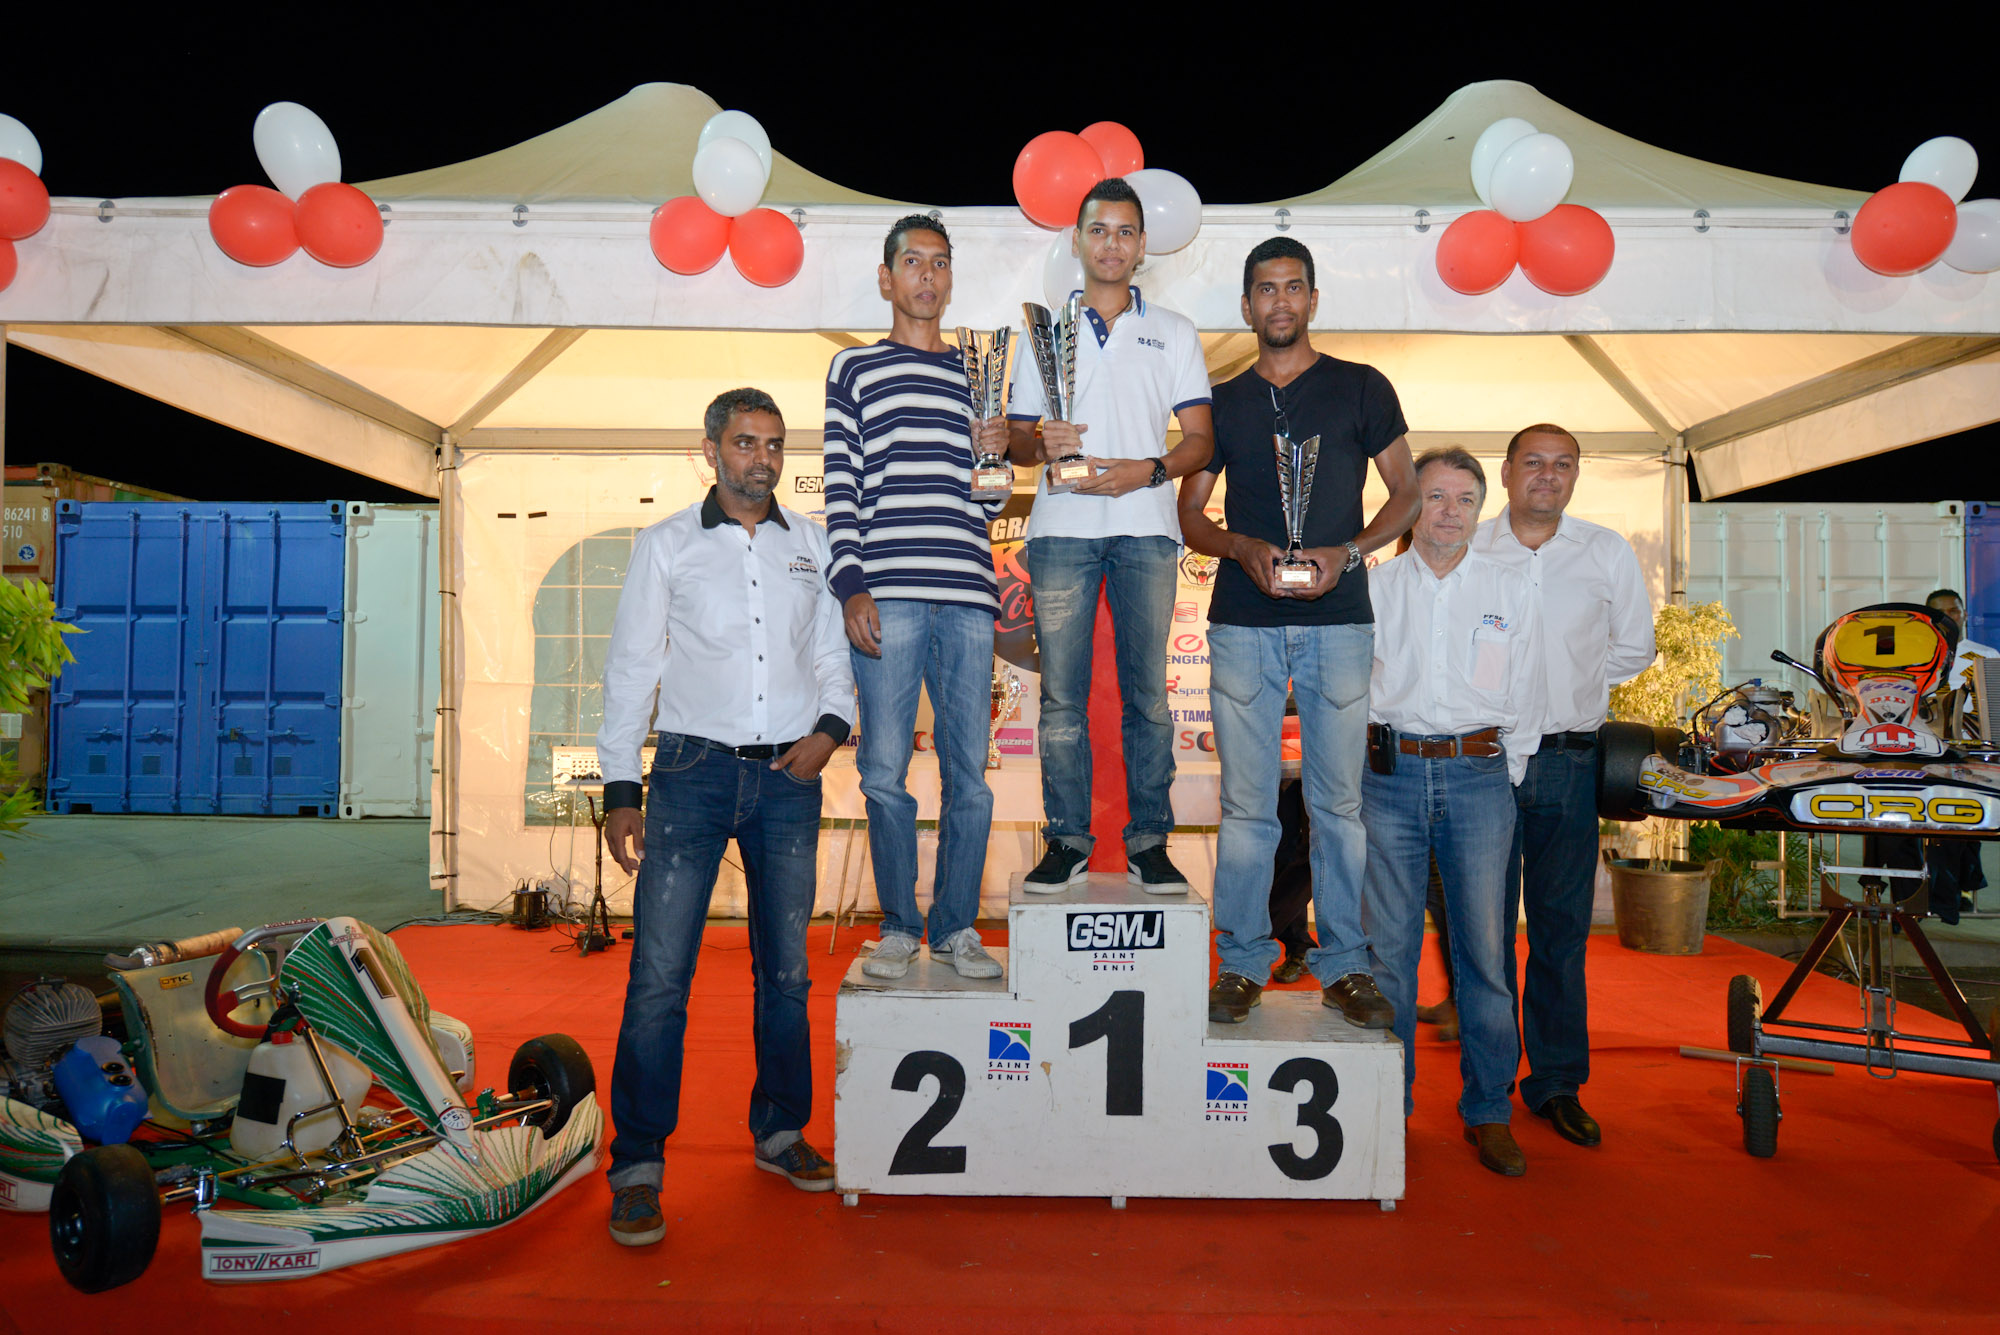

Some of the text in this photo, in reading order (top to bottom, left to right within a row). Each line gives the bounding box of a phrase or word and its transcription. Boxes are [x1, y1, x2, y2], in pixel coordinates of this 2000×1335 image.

[4, 507, 49, 521] 86241 8
[1864, 626, 1895, 655] 1
[1166, 655, 1210, 664] ENGEN
[1640, 771, 1711, 799] CRG
[1854, 767, 1928, 779] kcm
[1811, 795, 1984, 824] CRG
[1070, 913, 1162, 948] GSMJ
[351, 948, 396, 999] 1
[1068, 991, 1144, 1116] 1
[888, 1050, 967, 1176] 2
[1268, 1057, 1344, 1181] 3
